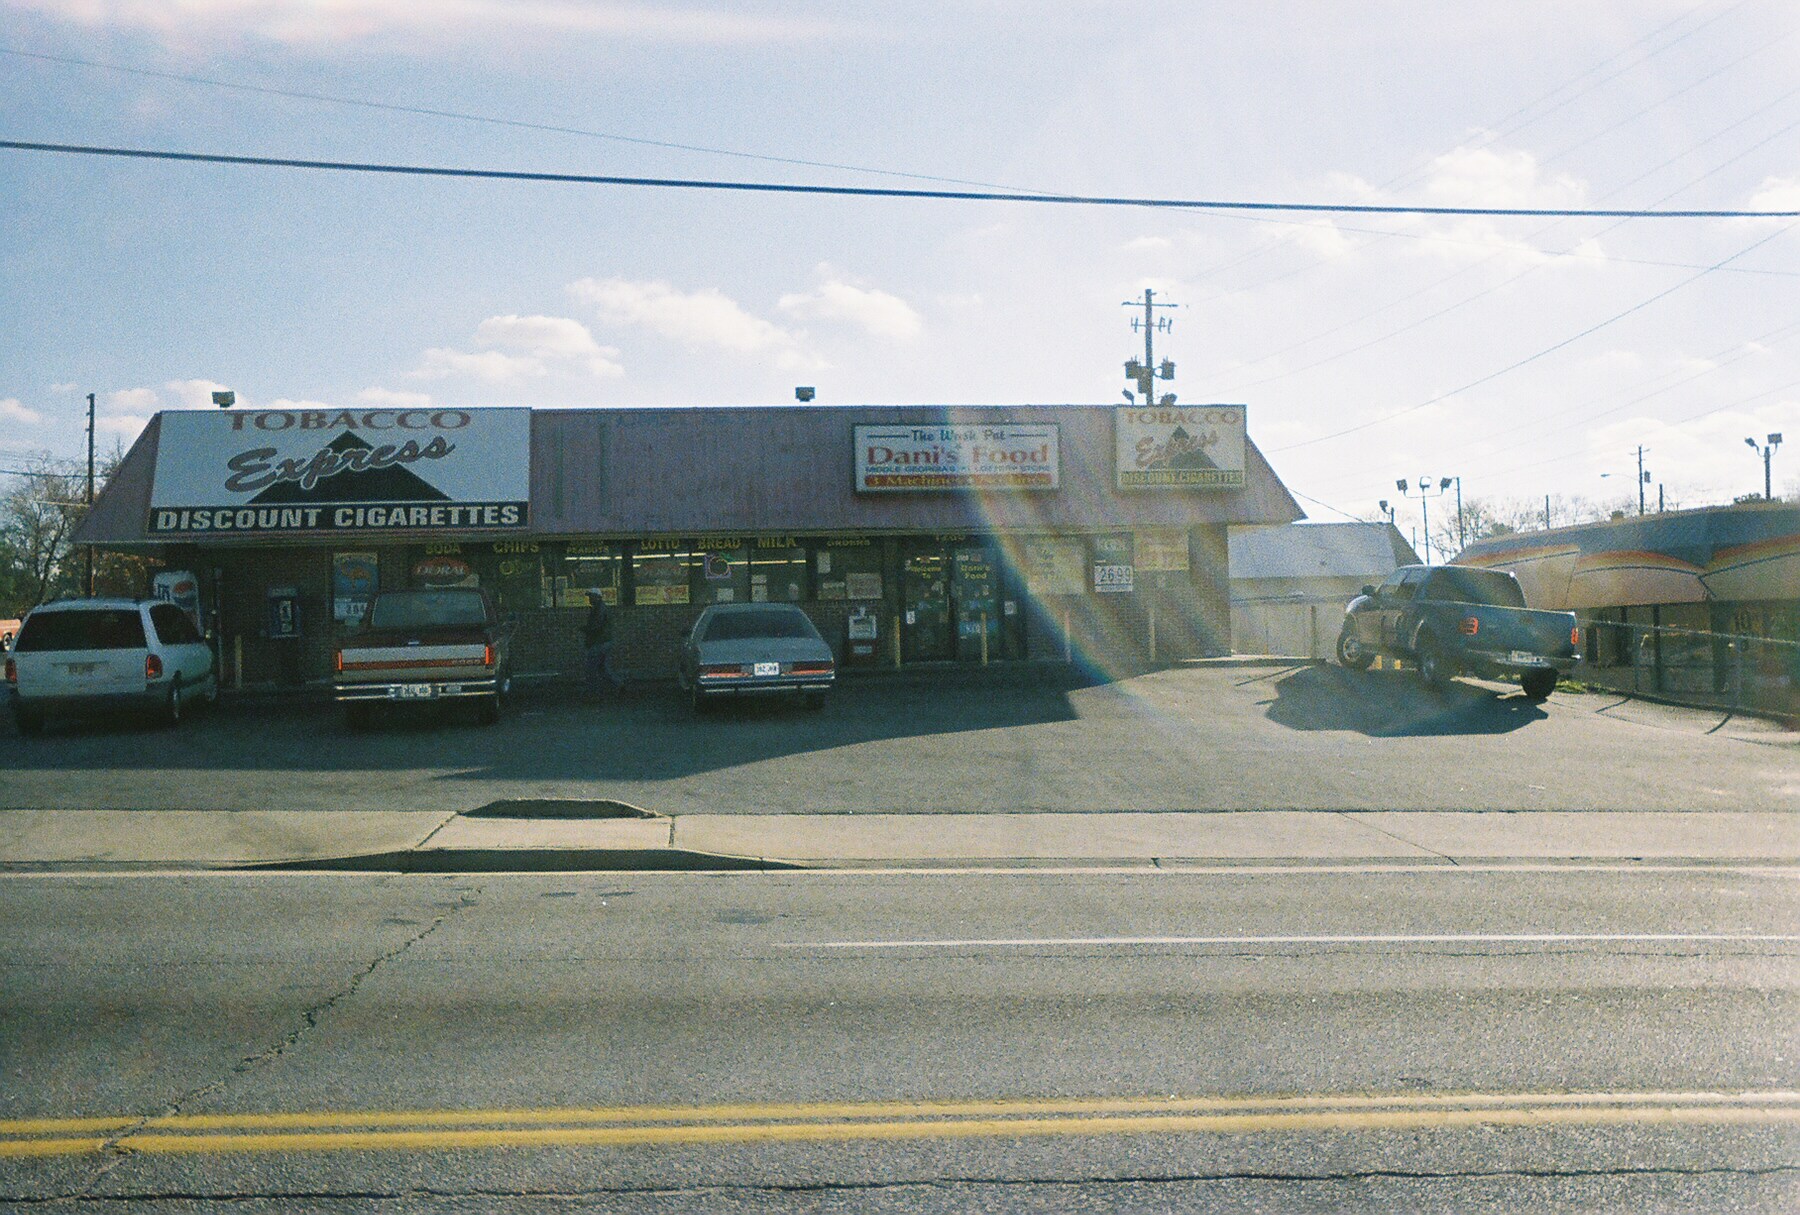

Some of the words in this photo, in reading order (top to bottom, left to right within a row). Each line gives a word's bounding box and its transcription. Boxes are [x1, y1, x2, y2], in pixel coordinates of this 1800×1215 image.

[224, 411, 471, 430] TOBACCO
[1126, 411, 1240, 424] TOBACCO
[911, 429, 934, 442] The
[866, 445, 959, 464] Dani's
[972, 444, 1049, 464] Food
[1135, 430, 1219, 469] Express
[224, 435, 456, 492] Express
[157, 508, 321, 530] DISCOUNT
[334, 505, 520, 527] CIGARETTES
[425, 542, 462, 554] SODA
[492, 541, 540, 554] CHIPS
[698, 538, 741, 549] BREAD
[757, 537, 797, 548] MILK
